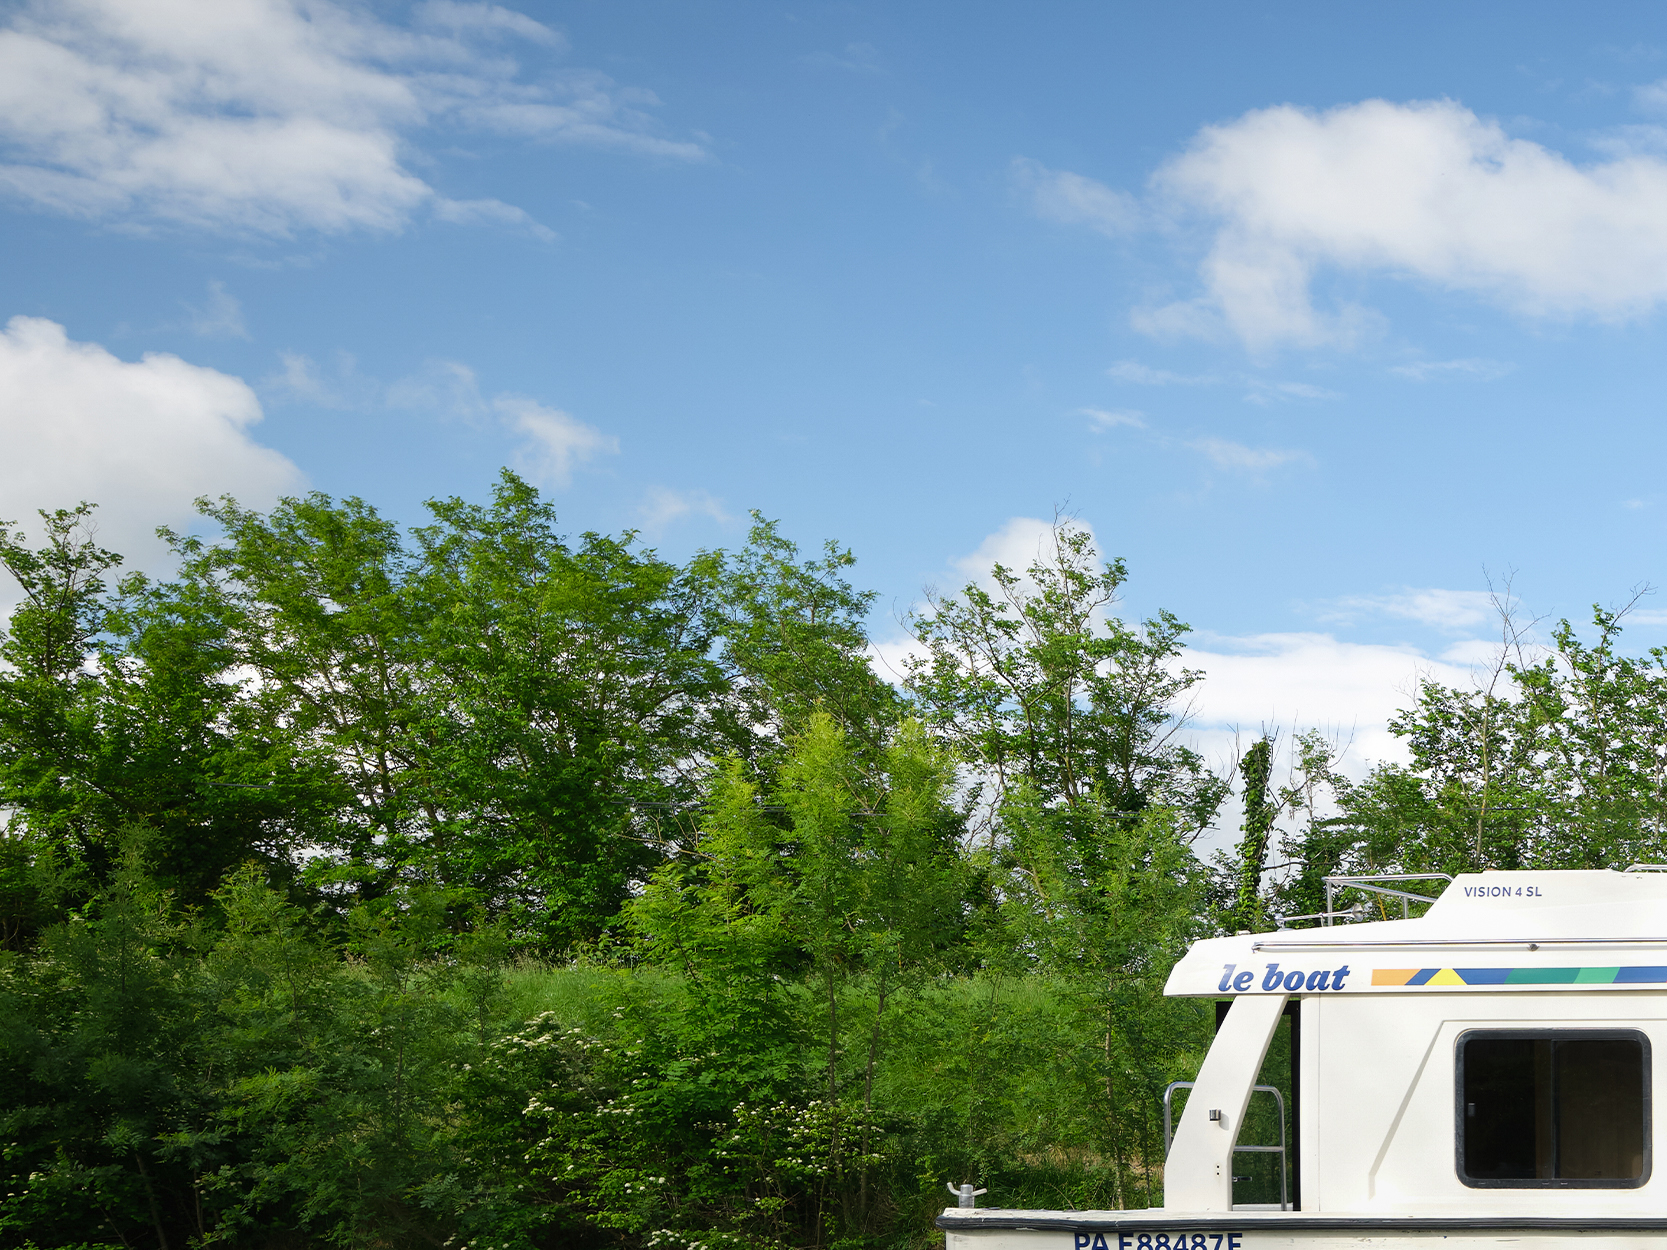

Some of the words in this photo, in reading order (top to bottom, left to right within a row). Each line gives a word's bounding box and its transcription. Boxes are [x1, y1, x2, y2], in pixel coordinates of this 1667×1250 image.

[1464, 886, 1511, 897] VISION
[1515, 887, 1522, 897] 4
[1526, 886, 1542, 897] SL
[1218, 964, 1254, 992] le
[1262, 963, 1350, 991] boat
